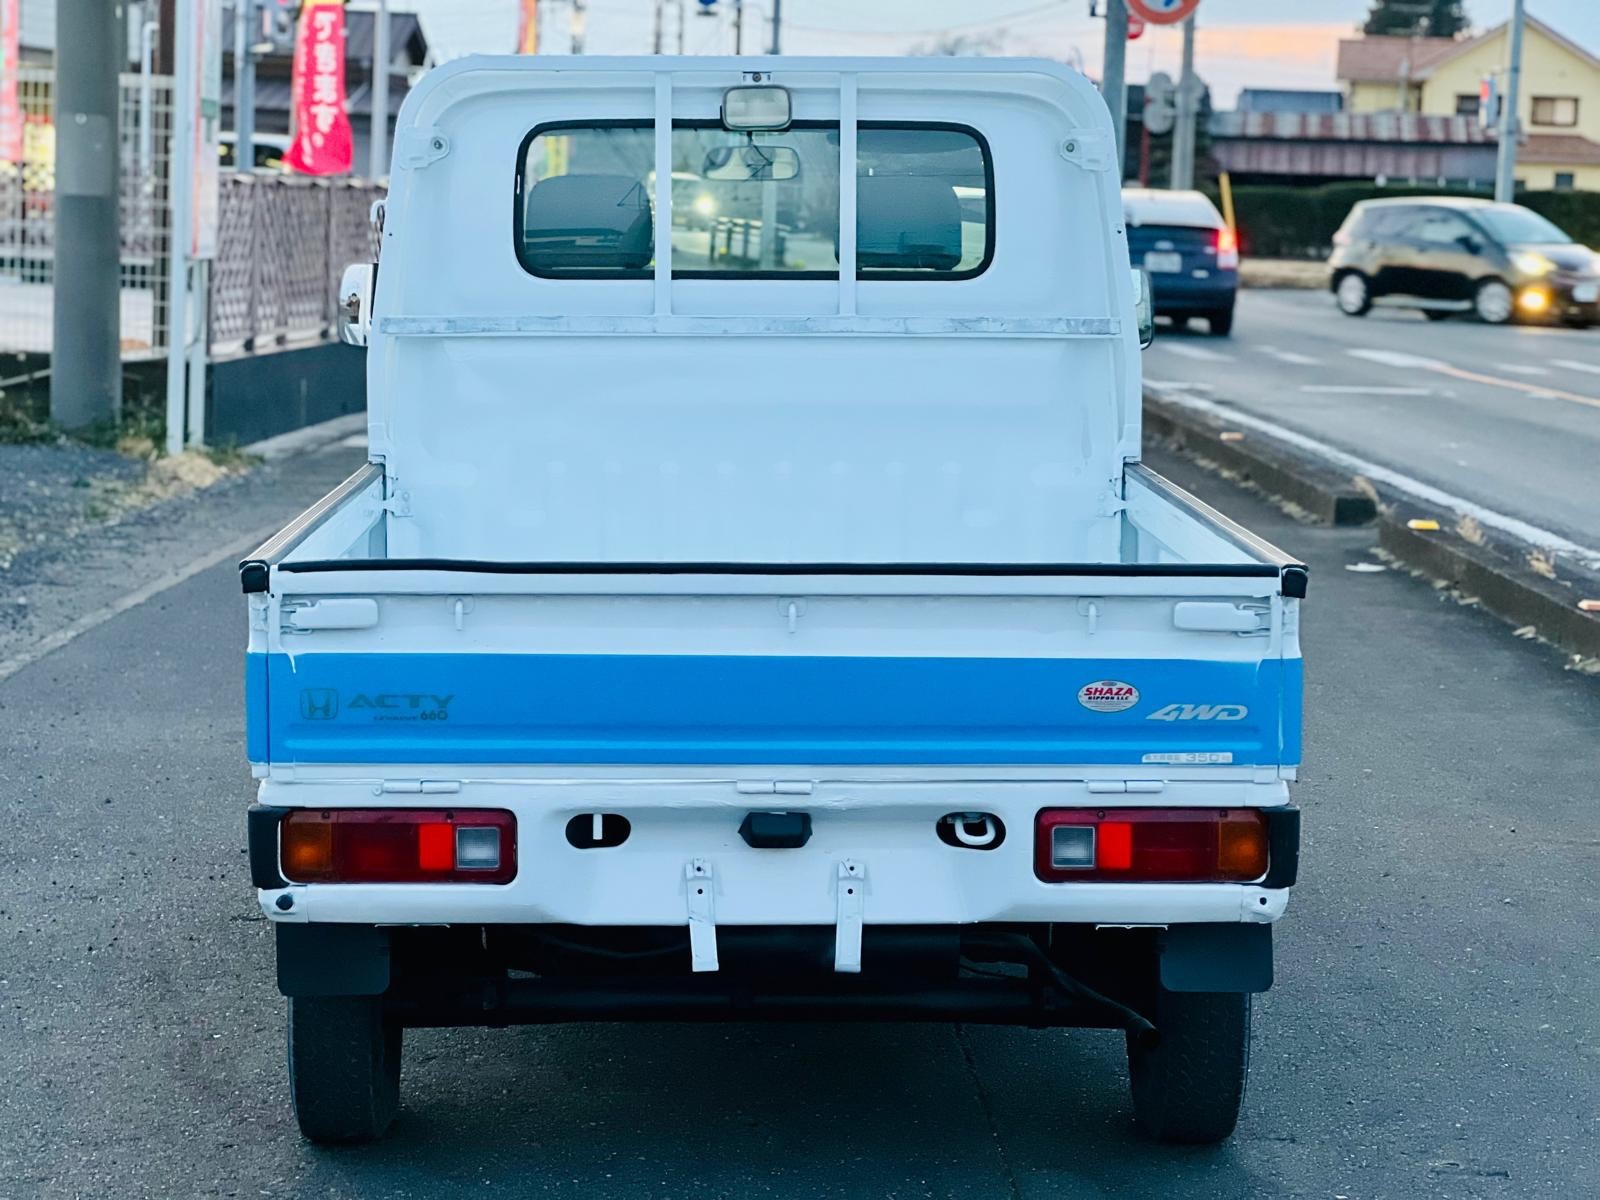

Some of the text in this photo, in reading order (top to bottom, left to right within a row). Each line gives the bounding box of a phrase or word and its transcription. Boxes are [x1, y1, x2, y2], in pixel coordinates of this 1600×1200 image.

[1084, 687, 1133, 696] SHAZA
[347, 693, 456, 709] ACTY
[420, 710, 449, 721] 660
[1145, 704, 1248, 721] 4WD
